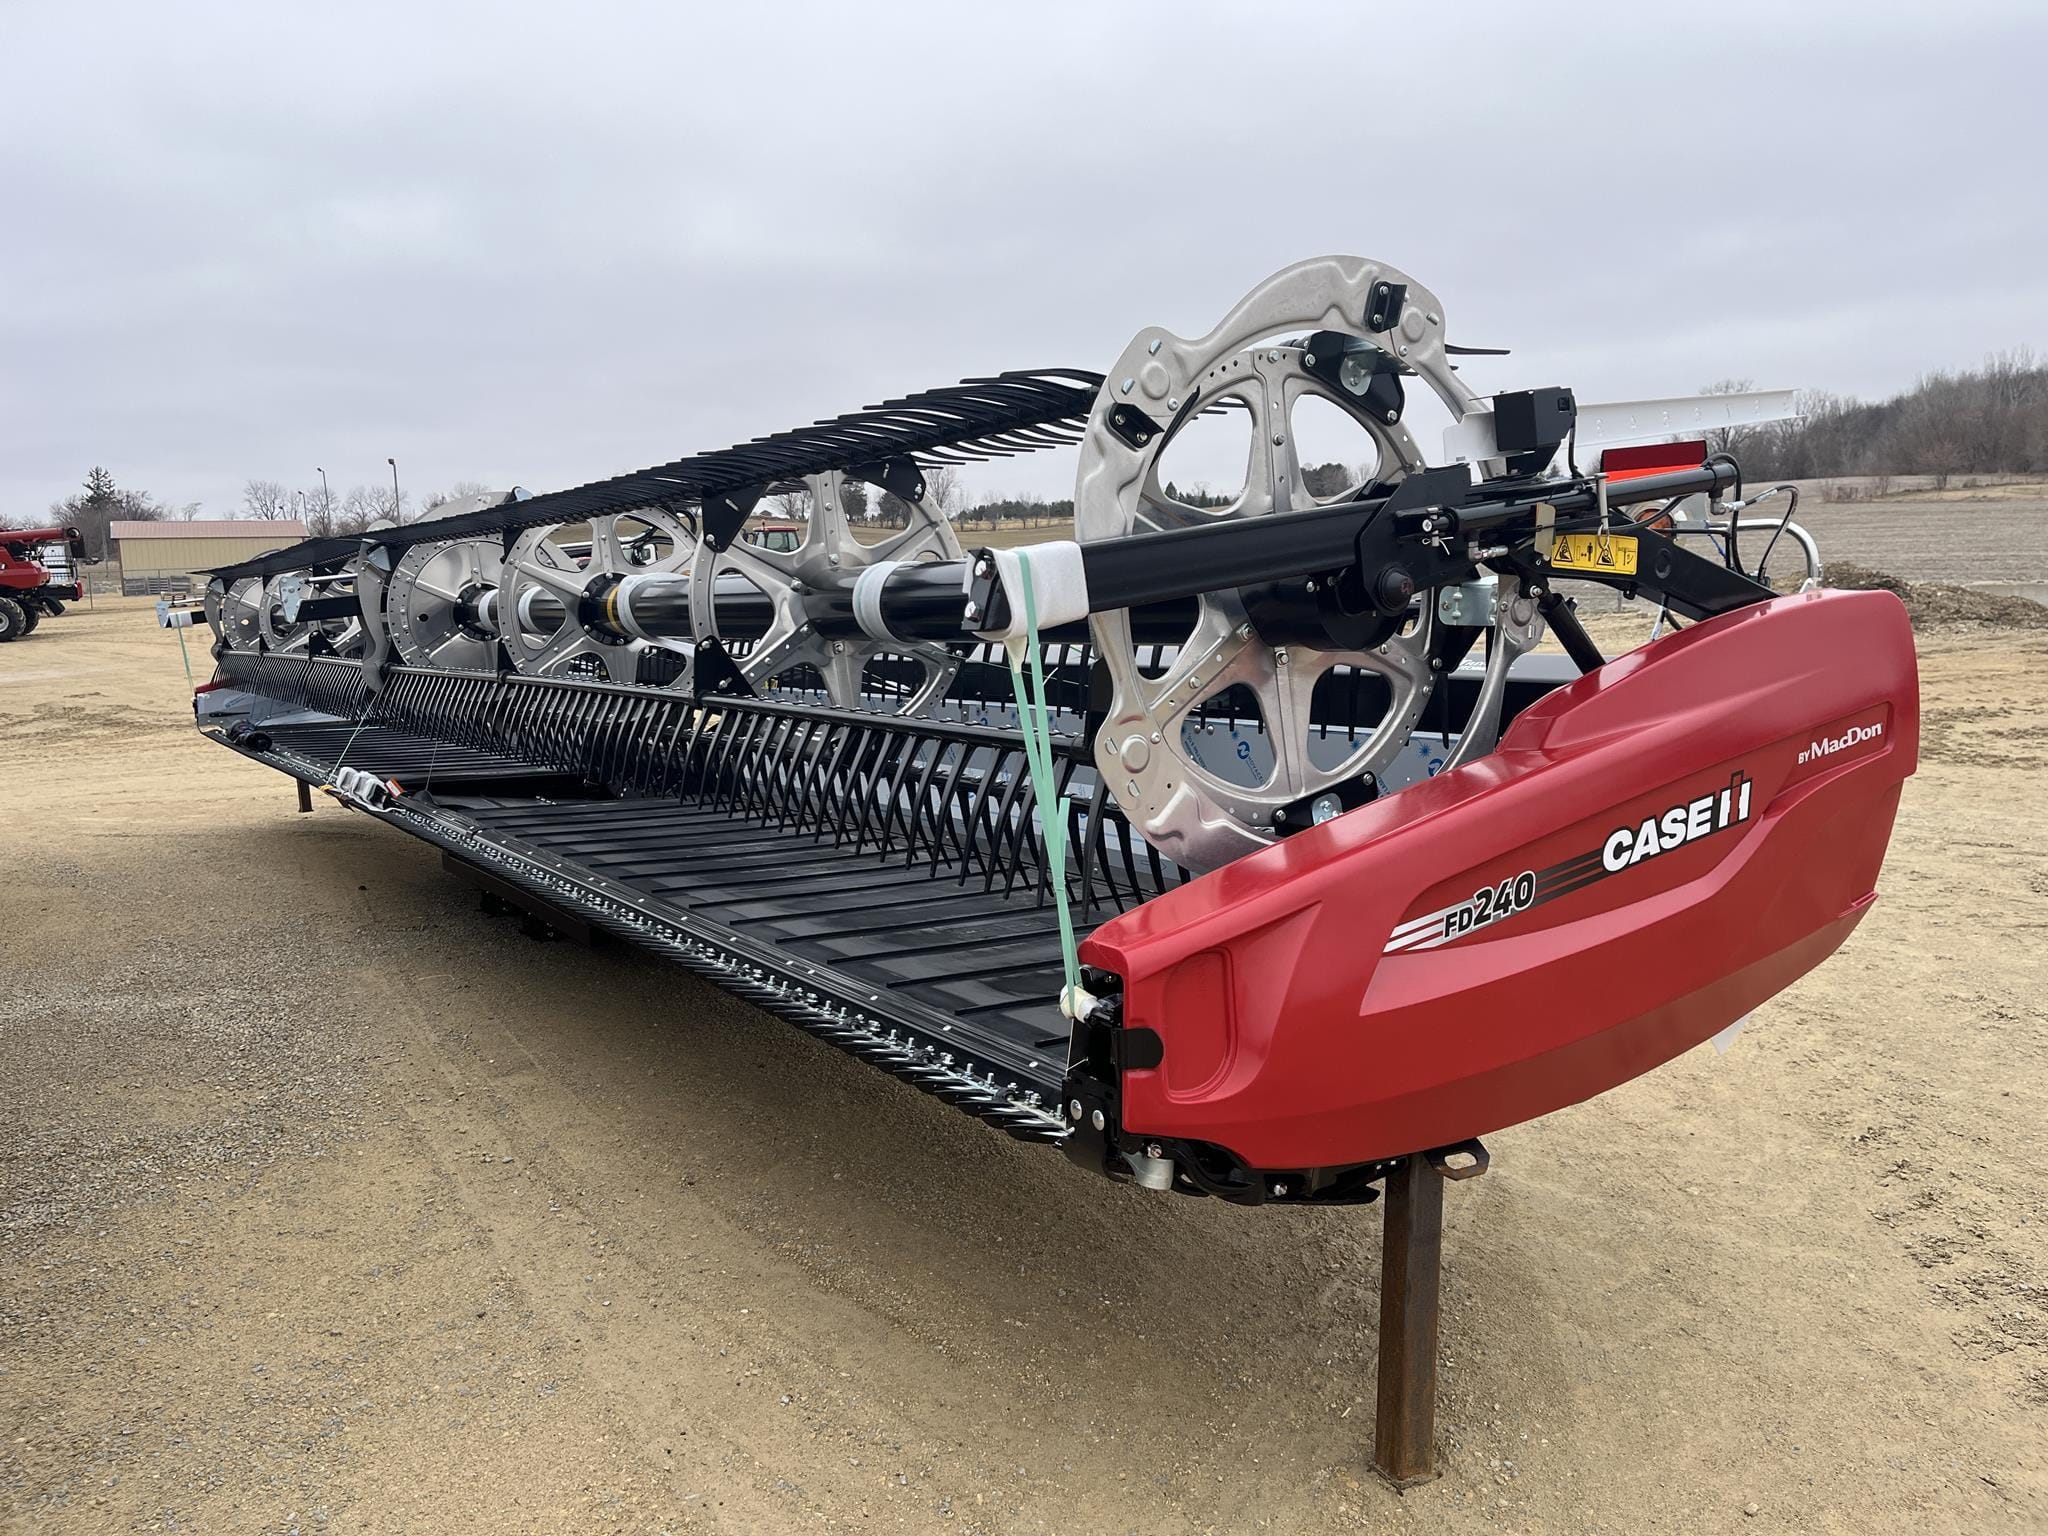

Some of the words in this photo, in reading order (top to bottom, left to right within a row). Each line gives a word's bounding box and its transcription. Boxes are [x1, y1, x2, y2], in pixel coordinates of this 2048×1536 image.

[1798, 749, 1811, 765] BY
[1811, 723, 1882, 760] MacDon
[1602, 794, 1714, 872] CASE
[1444, 871, 1535, 938] FD240
